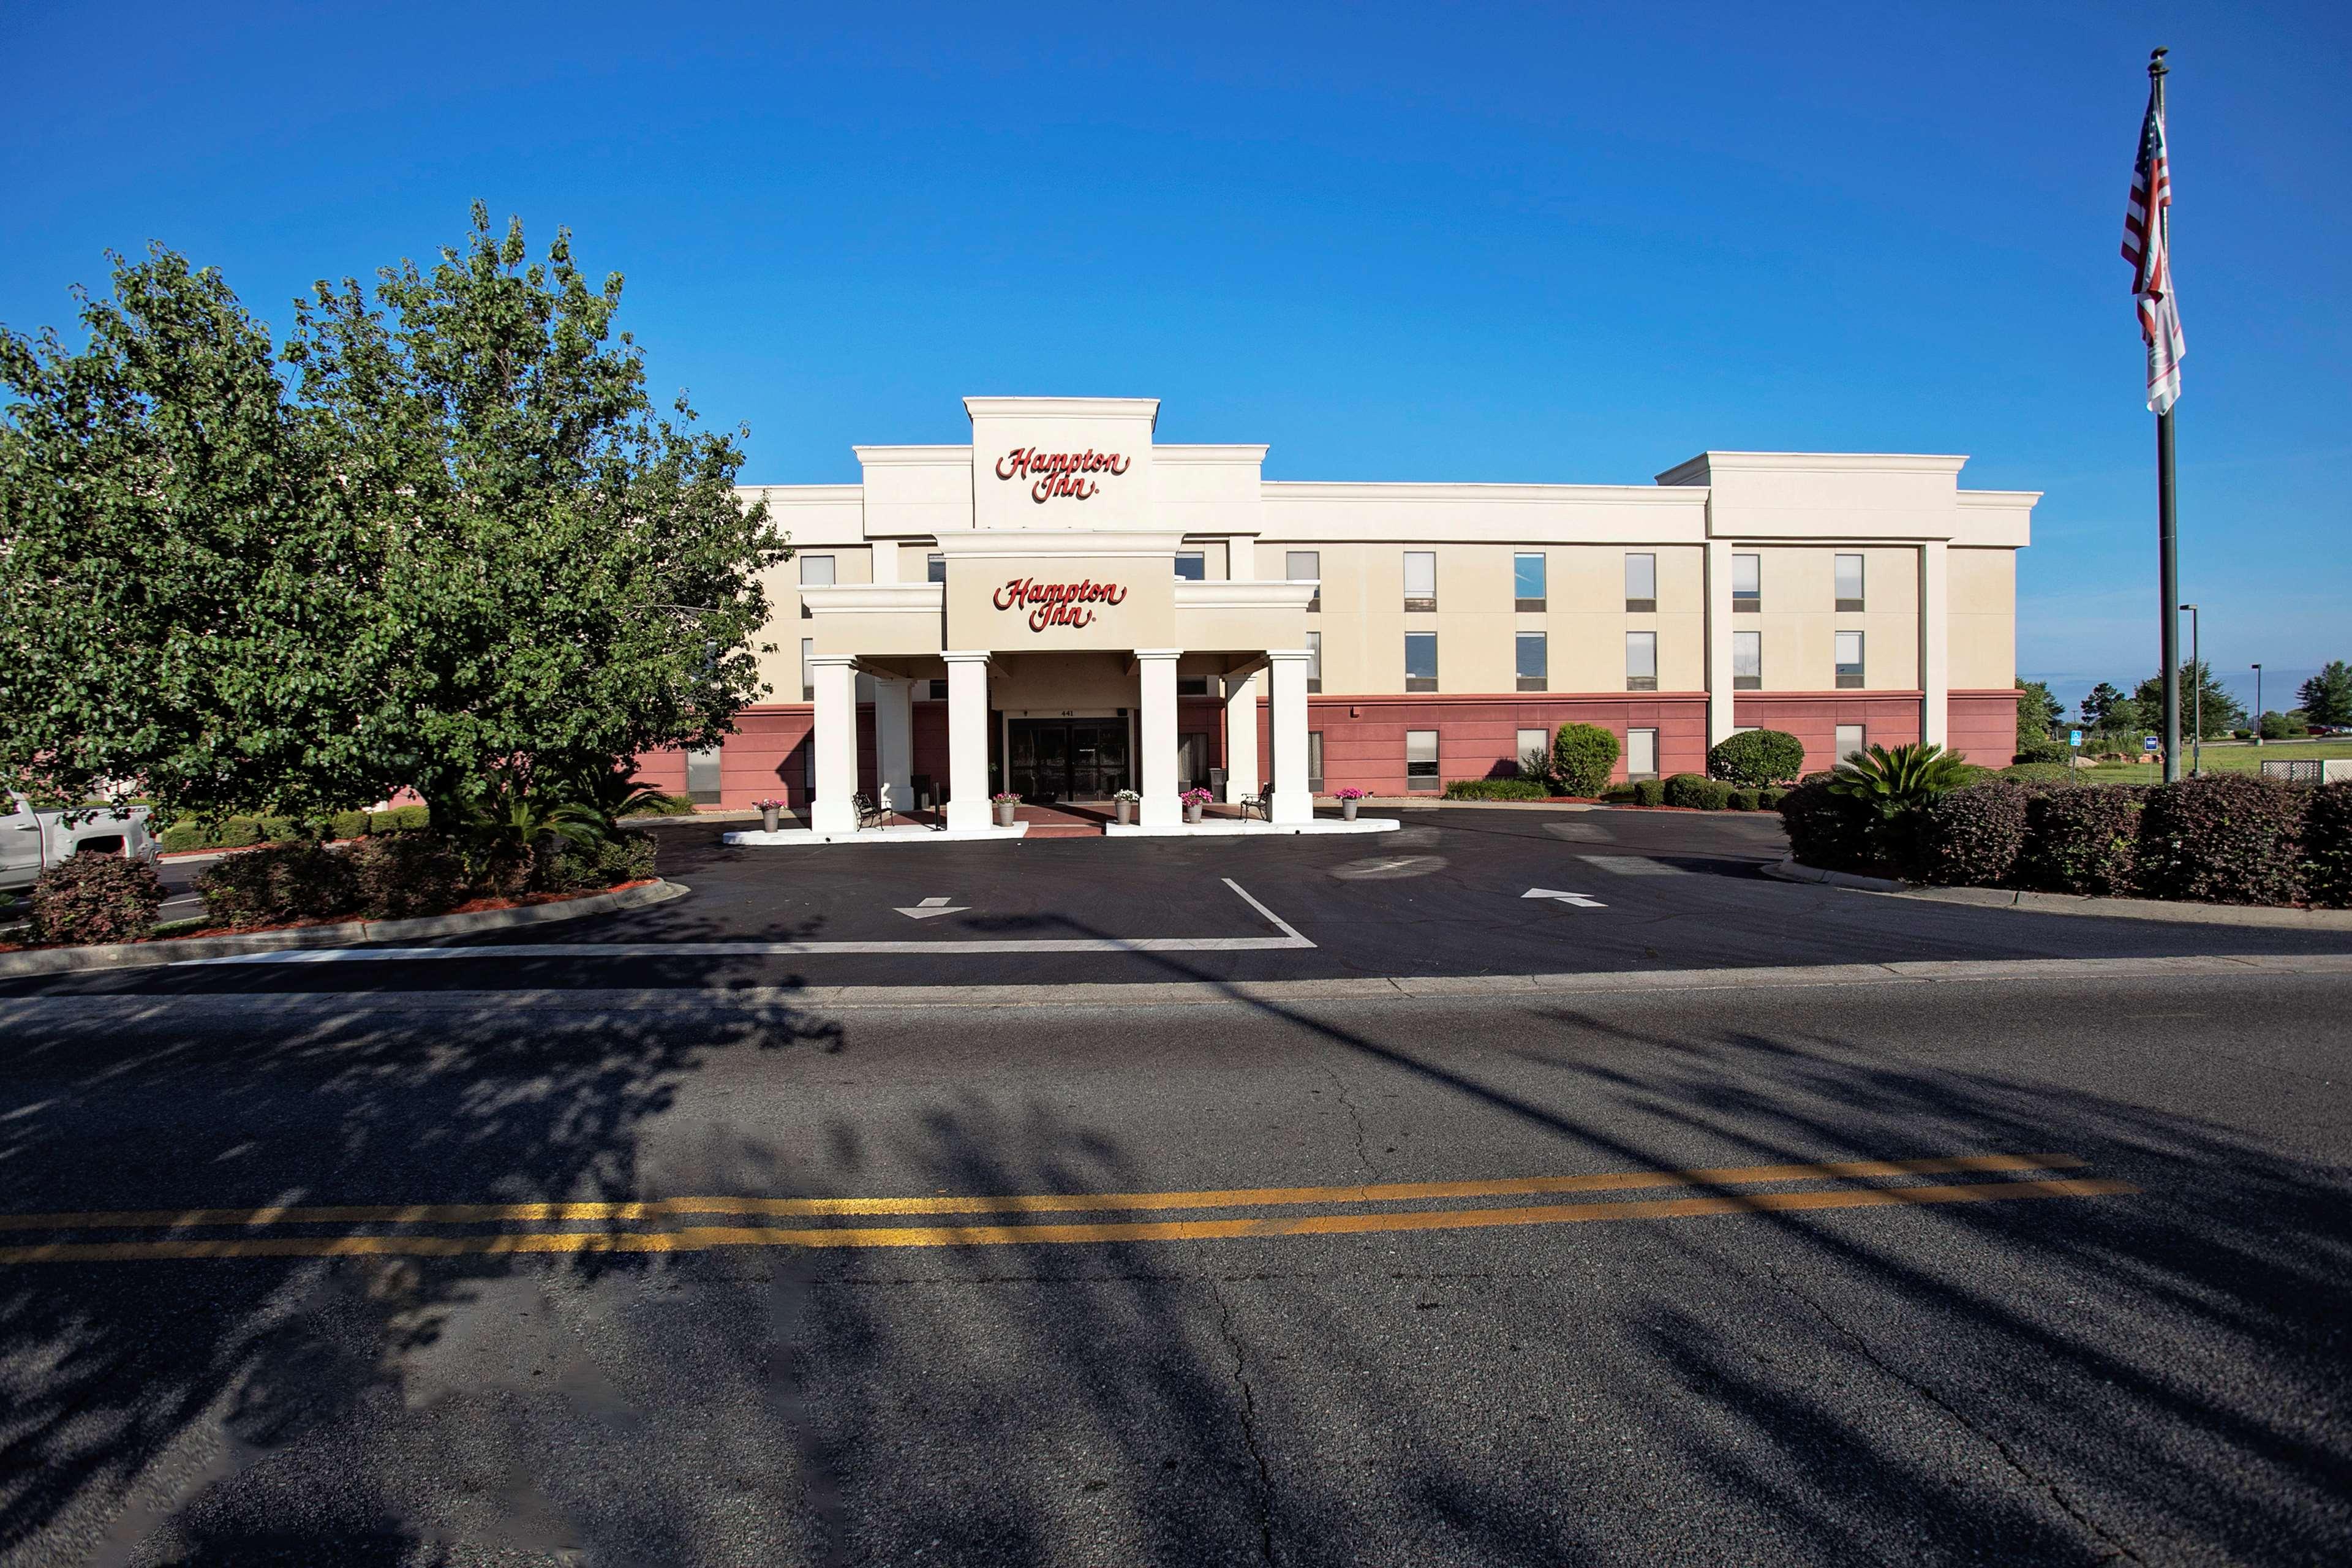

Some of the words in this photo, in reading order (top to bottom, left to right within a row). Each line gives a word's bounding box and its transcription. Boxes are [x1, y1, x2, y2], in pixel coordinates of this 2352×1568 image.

[995, 447, 1130, 480] Hampton
[1031, 471, 1096, 504] Inn
[993, 577, 1127, 610] Hampton
[1028, 600, 1092, 633] Inn
